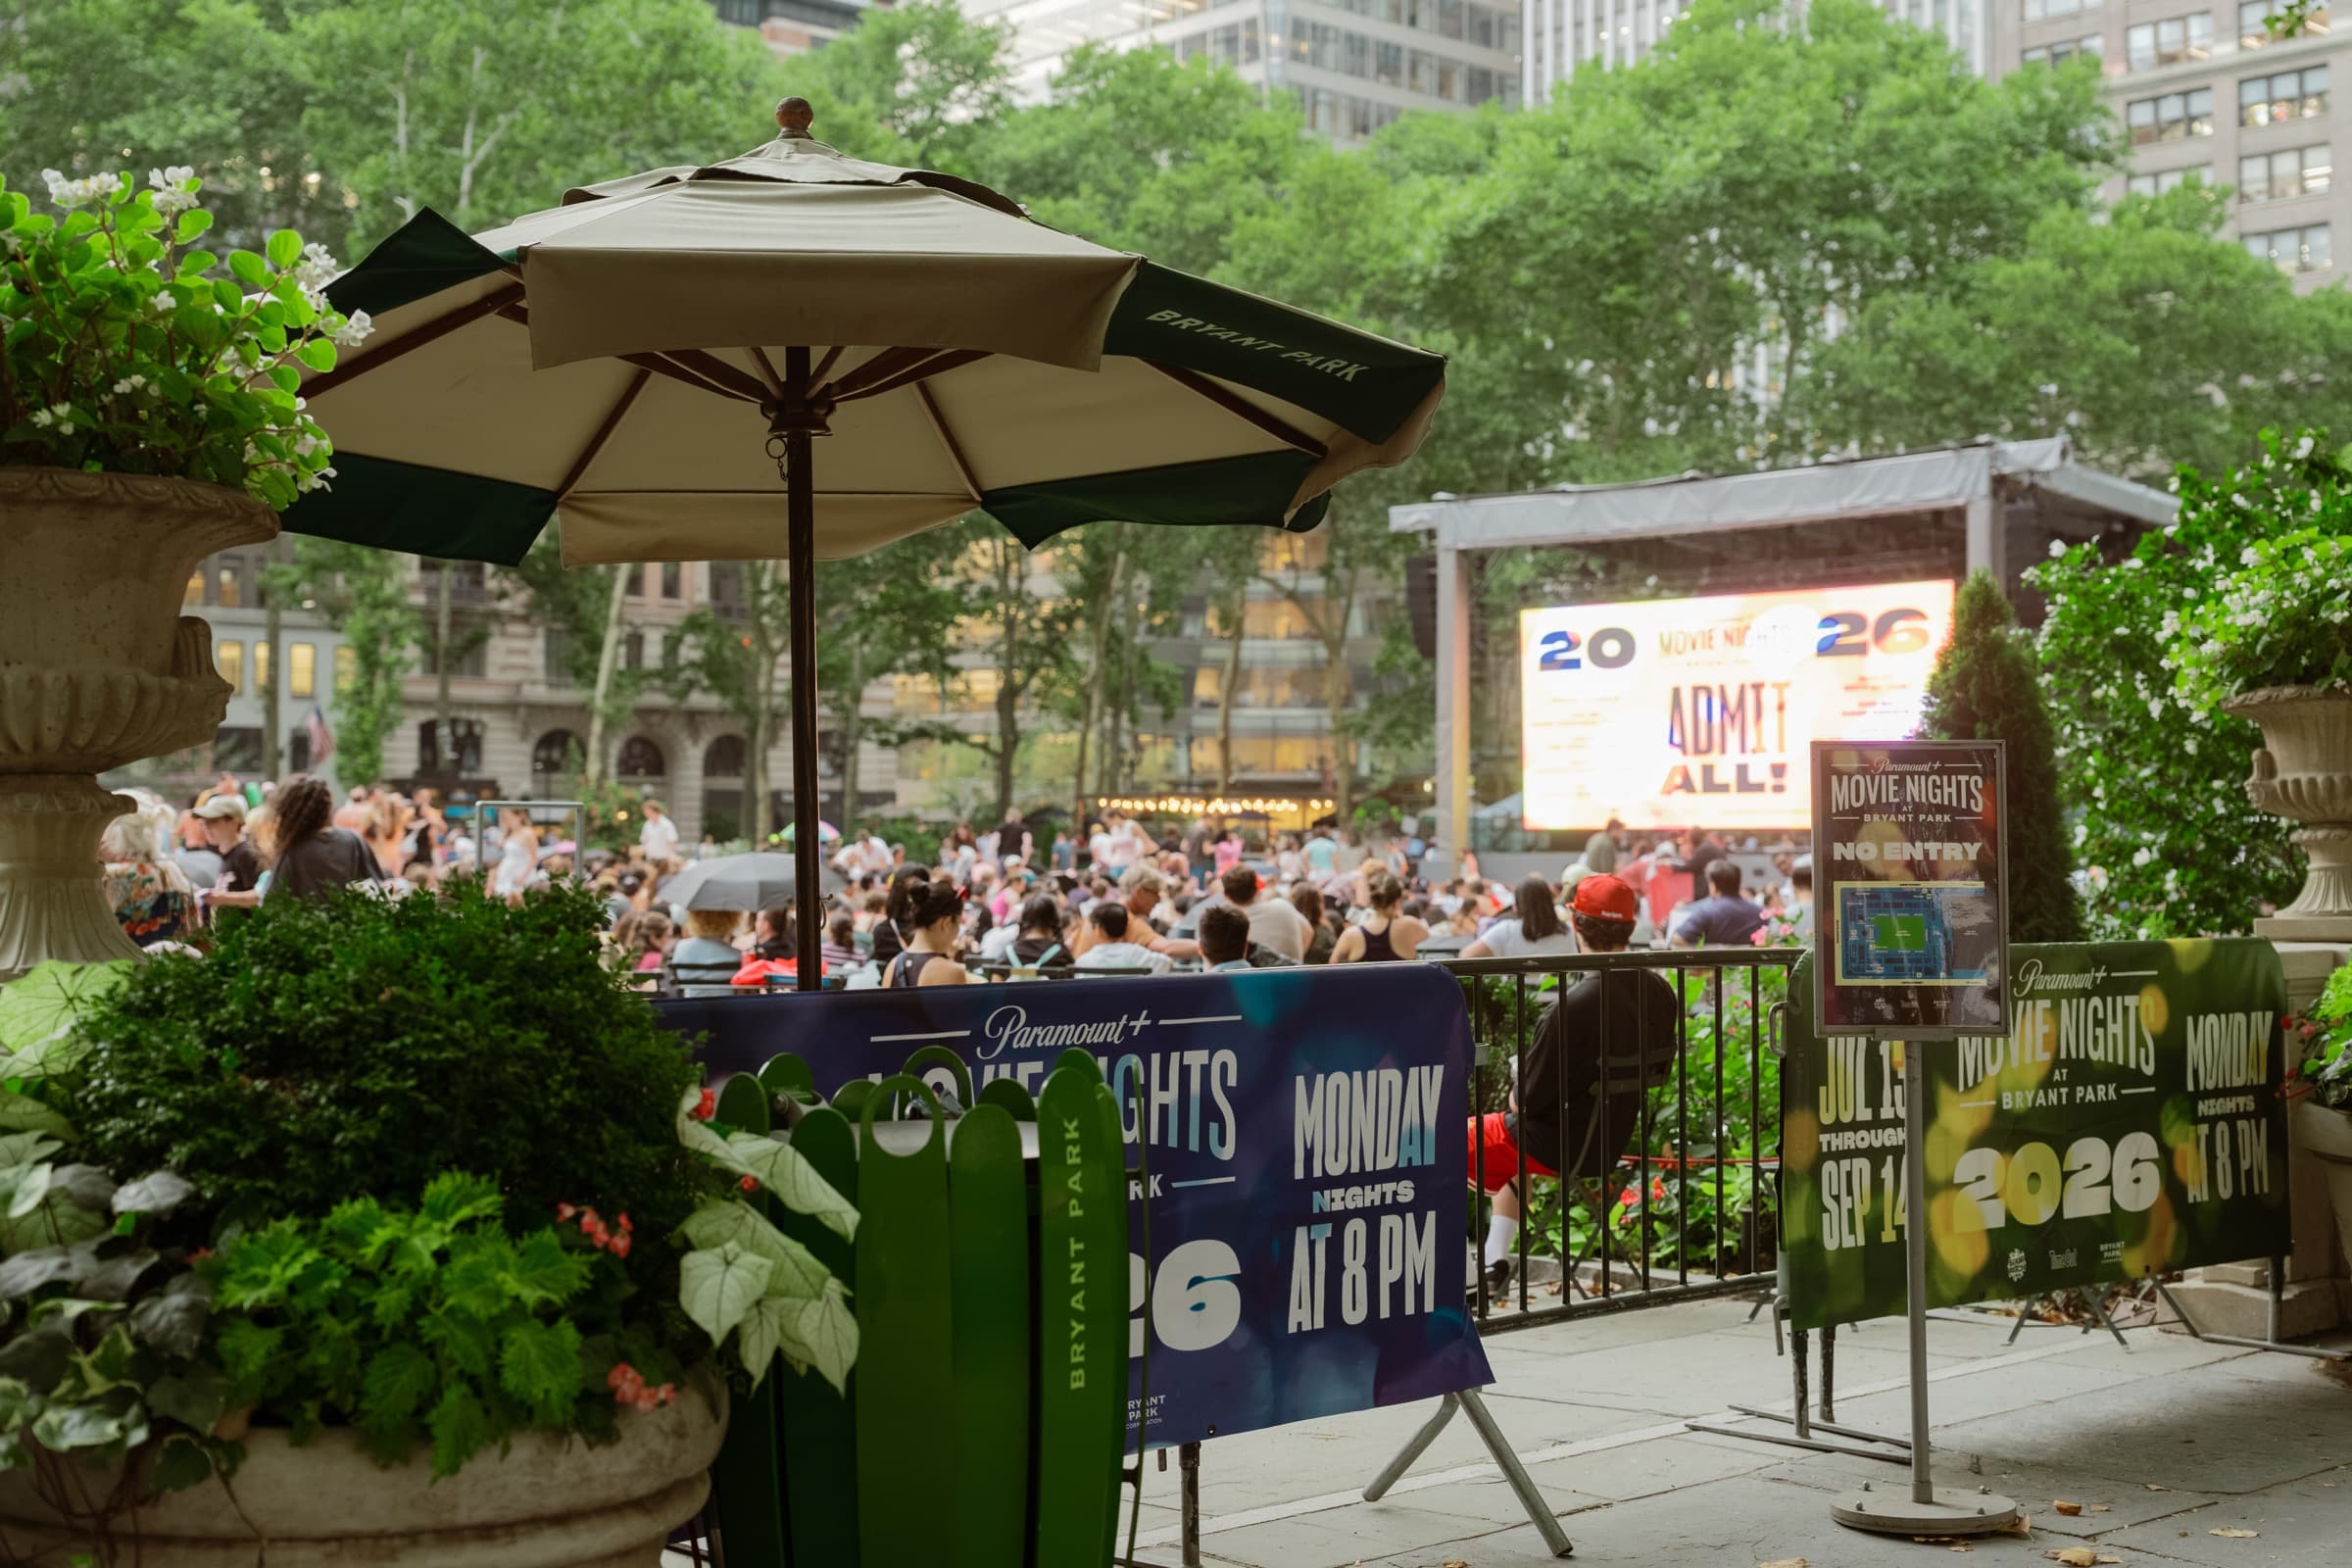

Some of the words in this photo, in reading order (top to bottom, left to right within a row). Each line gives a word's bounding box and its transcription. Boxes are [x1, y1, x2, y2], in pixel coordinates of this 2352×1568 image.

[1146, 310, 1286, 351] BRYANT
[1281, 350, 1370, 382] PARK
[1539, 626, 1636, 671] 20
[1816, 609, 1930, 658] 26
[1668, 682, 1791, 758] ADMIT
[1660, 762, 1788, 795] ALL!
[1871, 756, 1942, 774] Paramount+
[1831, 774, 1900, 813] MOVIE
[1905, 774, 1984, 813] NIGHTS
[1863, 813, 1914, 822] BRYANT
[1919, 813, 1952, 823] PARK
[1833, 842, 1878, 861] NO
[1884, 842, 1984, 861] ENTRY
[2014, 958, 2107, 998] Paramount+
[976, 1004, 1152, 1059] Paramount+
[1958, 1000, 2051, 1093] MOVIE
[2060, 995, 2156, 1077] NIGHTS
[2186, 1010, 2274, 1093] MONDAY
[1819, 1037, 1873, 1125] JUL
[2001, 1088, 2069, 1110] BRYANT
[2075, 1083, 2117, 1106] PARK
[2053, 1068, 2068, 1082] AT
[1102, 1049, 1238, 1161] GHTS
[1295, 1064, 1445, 1180] MONDAY
[2197, 1096, 2255, 1117] NIGHTS
[1819, 1127, 1906, 1152] THROUGH
[2187, 1123, 2210, 1204] AT
[2216, 1120, 2233, 1200] 8
[2236, 1117, 2270, 1197] PM
[1063, 1116, 1085, 1218] PARK
[1128, 1174, 1163, 1200] RK
[1952, 1131, 2161, 1234] 2026
[1312, 1180, 1415, 1214] NIGHTS
[1821, 1157, 1872, 1251] SEP
[1288, 1222, 1333, 1334] AT
[1342, 1217, 1368, 1325] 8
[1379, 1210, 1437, 1319] PM
[1069, 1237, 1085, 1390] BRYANT
[1127, 1395, 1166, 1409] RYNT
